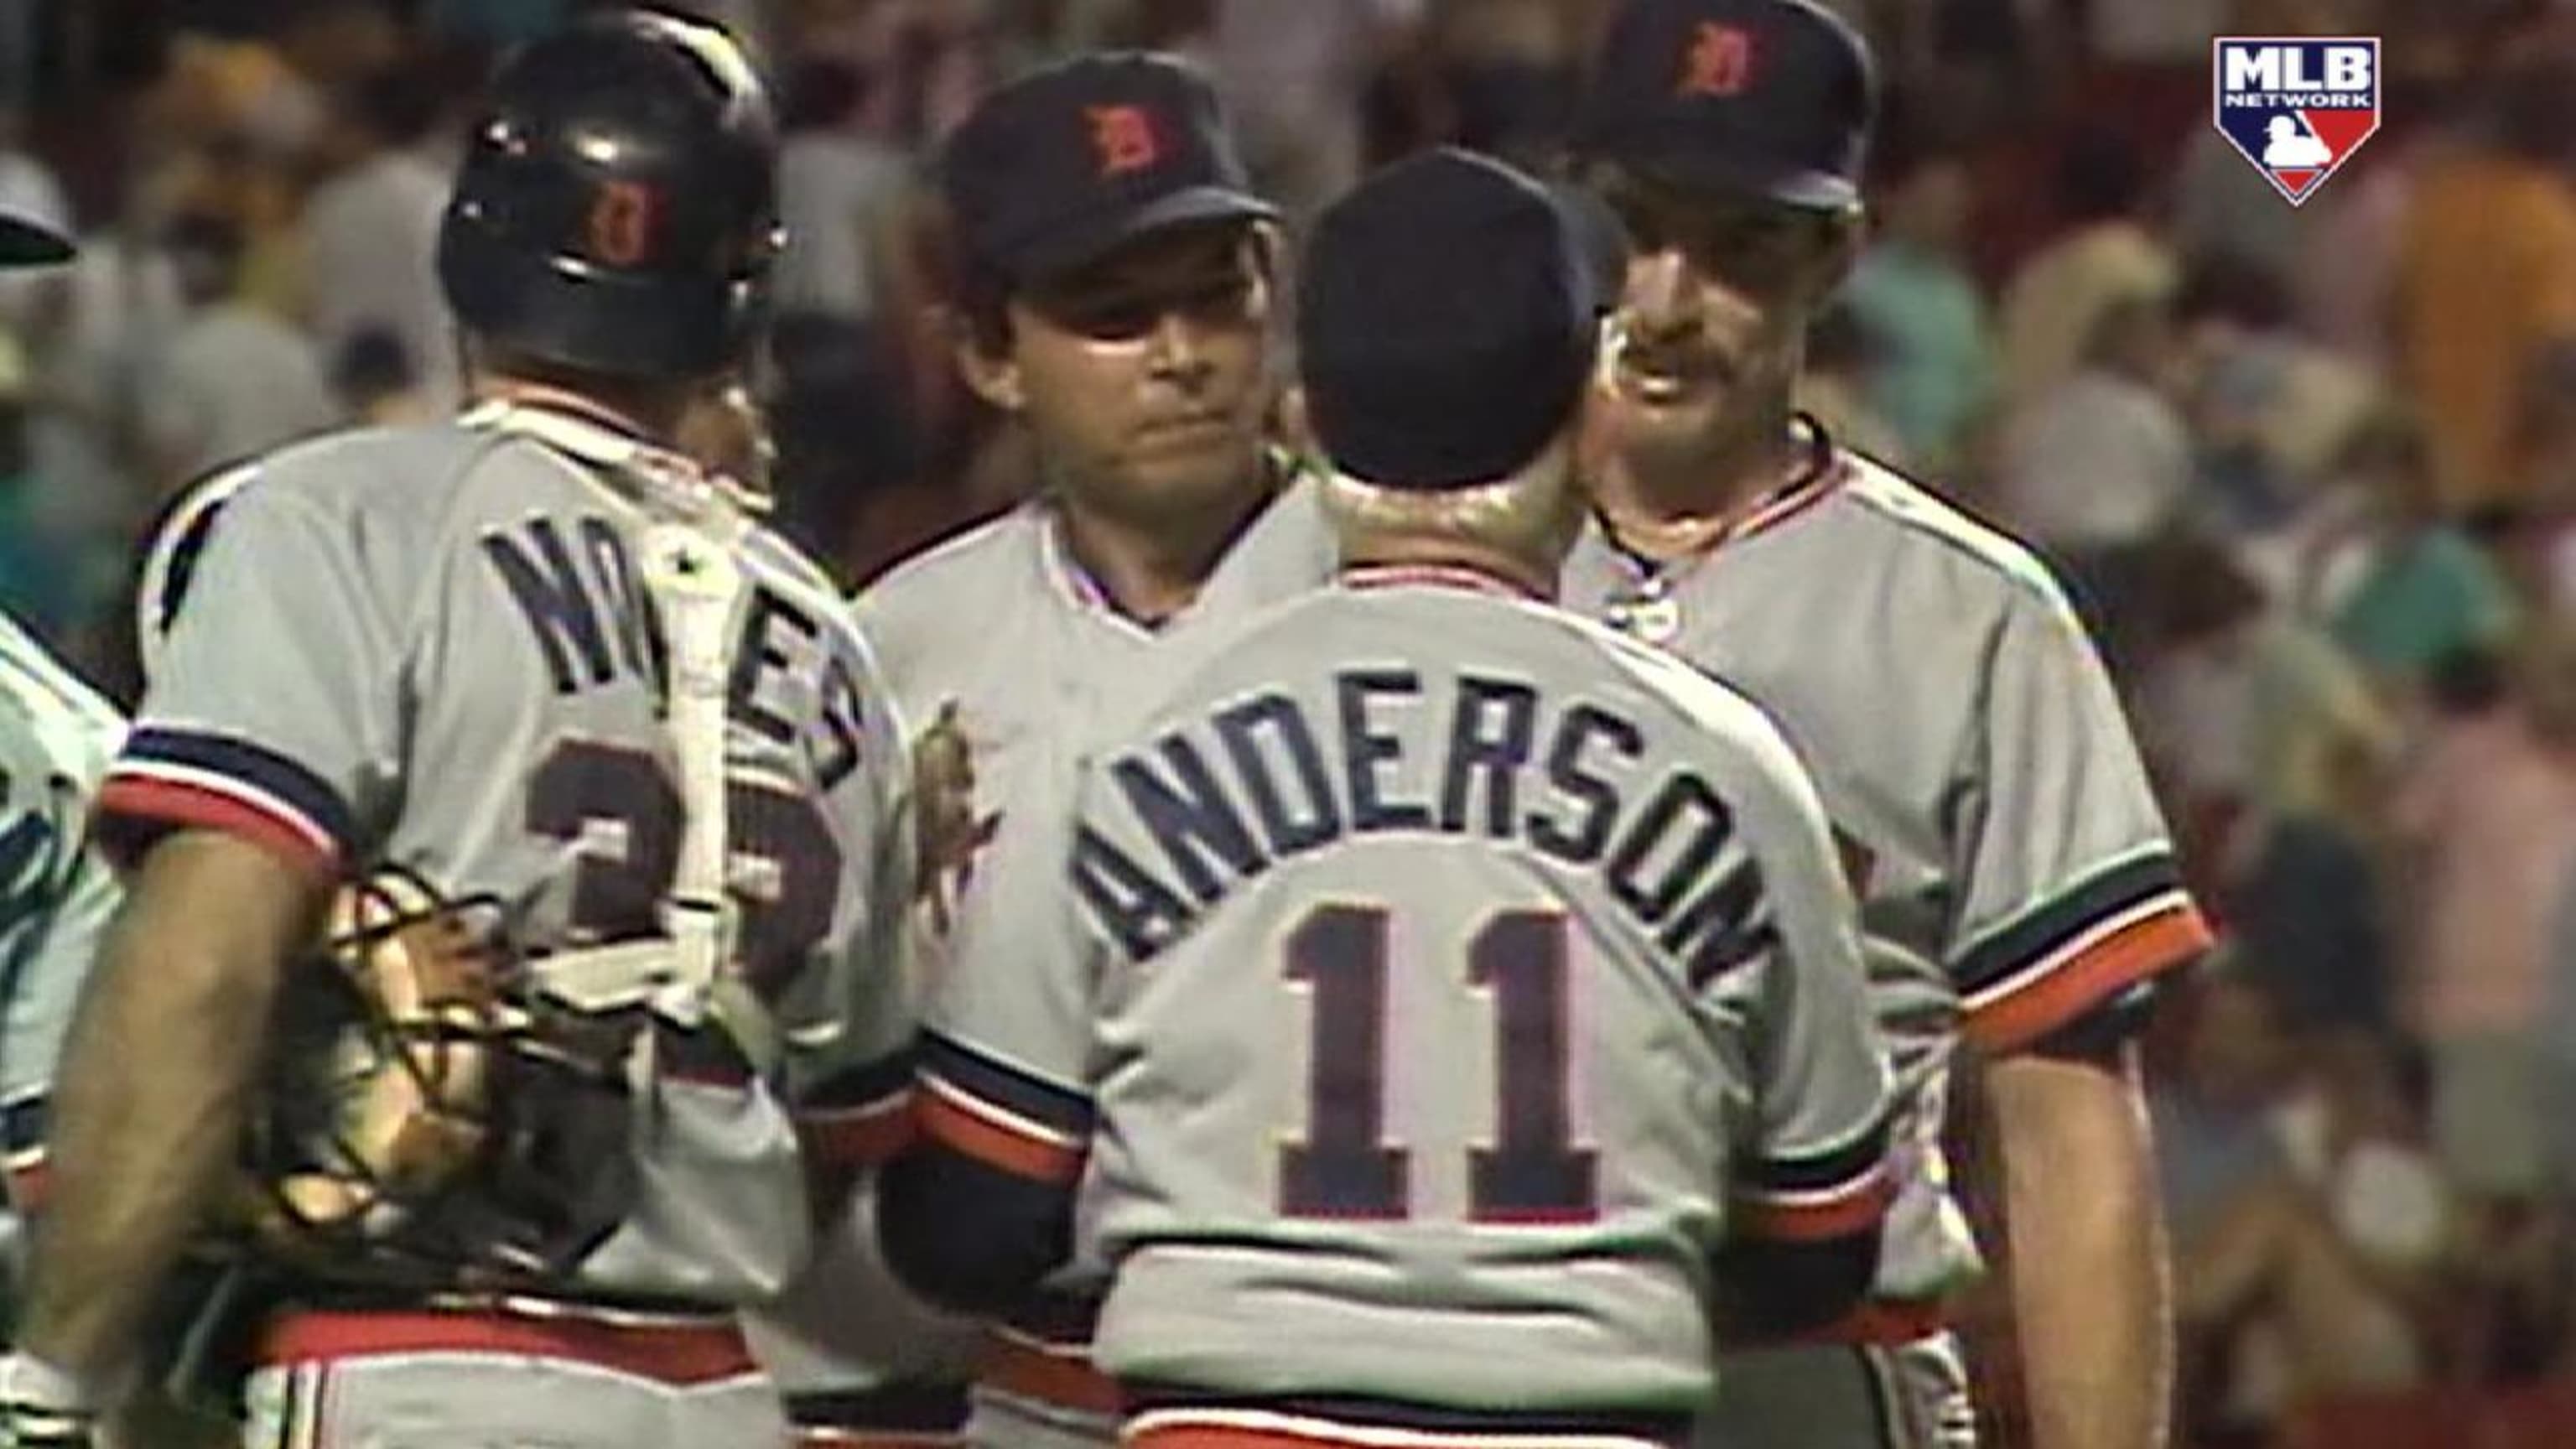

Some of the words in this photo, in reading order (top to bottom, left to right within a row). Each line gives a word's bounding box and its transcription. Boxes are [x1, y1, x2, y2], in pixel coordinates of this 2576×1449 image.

[480, 517, 860, 792] NOES
[1070, 669, 1781, 992] ANDERSON
[1277, 904, 1601, 1224] 11
